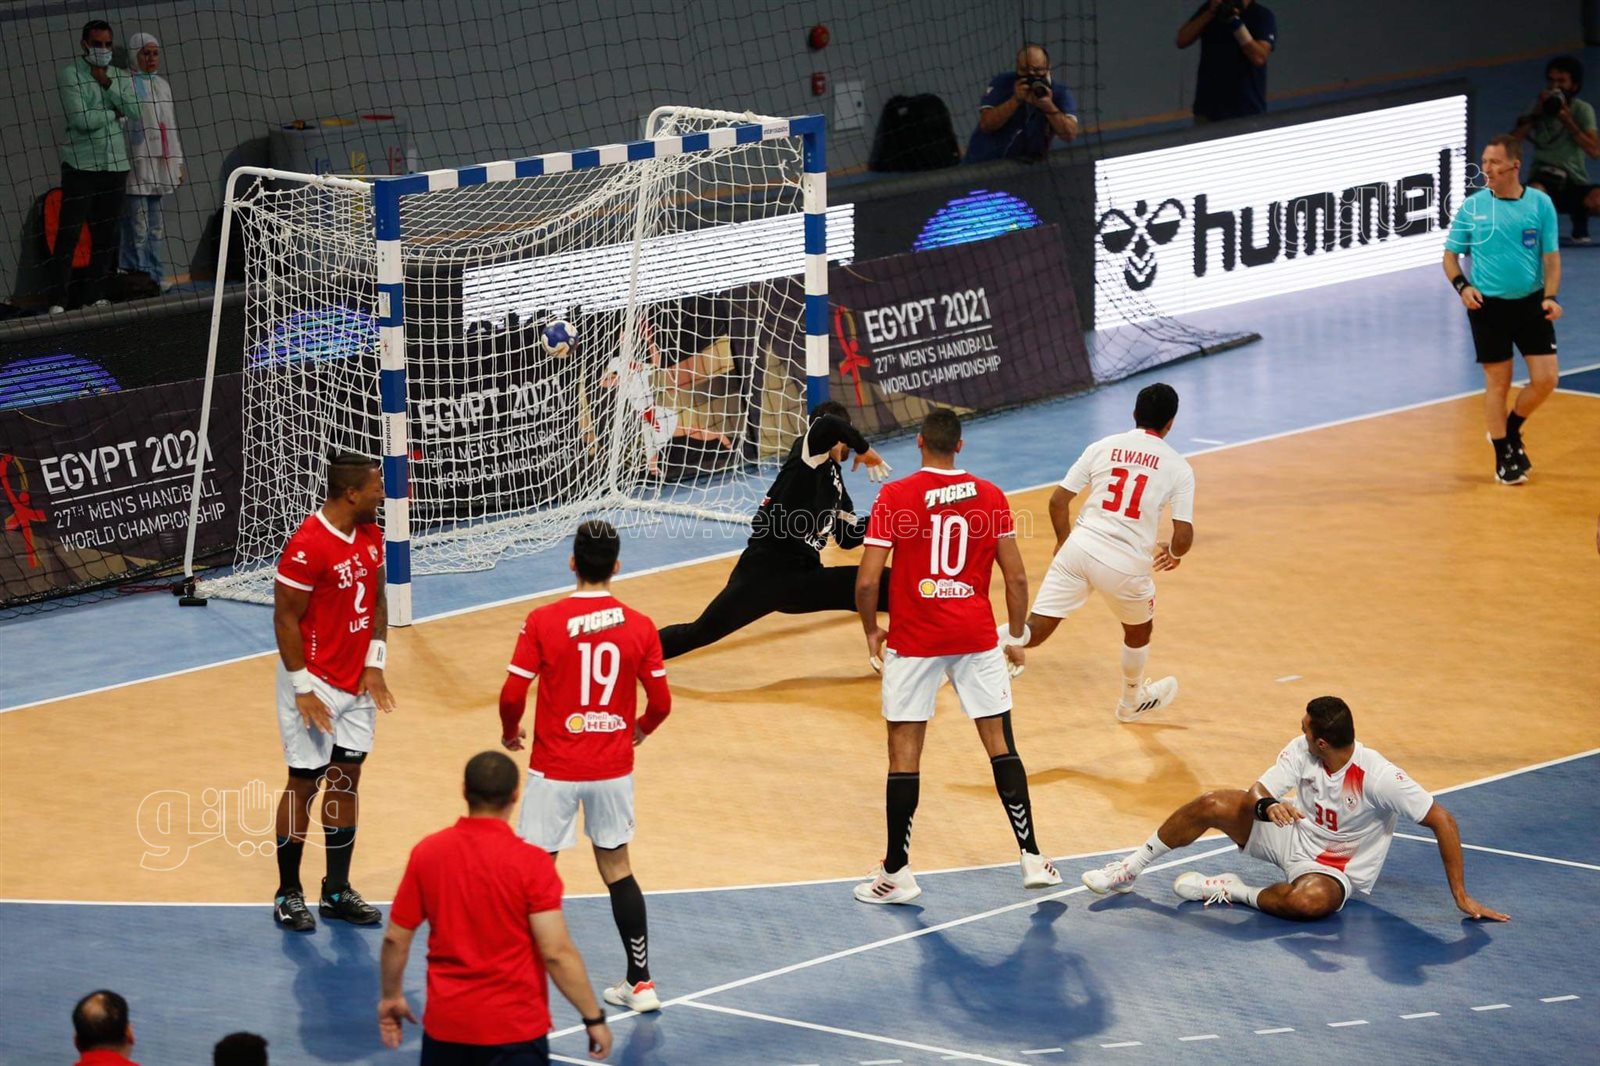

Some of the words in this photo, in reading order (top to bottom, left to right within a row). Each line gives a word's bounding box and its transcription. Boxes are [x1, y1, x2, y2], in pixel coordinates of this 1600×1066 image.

[1193, 147, 1451, 278] hummel
[863, 298, 937, 344] EGYPT
[940, 287, 991, 328] 2021
[874, 354, 898, 374] 27TH
[900, 347, 937, 369] MEN'S
[939, 334, 999, 360] HANDBALL
[880, 372, 921, 395] WORLD
[921, 355, 1001, 386] CHAMPIONSHIP
[417, 388, 500, 434] EGYPT
[40, 440, 137, 495] EGYPT
[54, 504, 85, 528] 27TH
[88, 497, 137, 522] MEN'S
[925, 481, 977, 509] TIGER
[1102, 467, 1149, 520] 31
[59, 526, 115, 552] WORLD
[930, 514, 969, 577] 10
[338, 566, 353, 589] 33
[567, 607, 625, 638] TIGER
[577, 641, 621, 706] 19
[1314, 802, 1338, 832] 39
